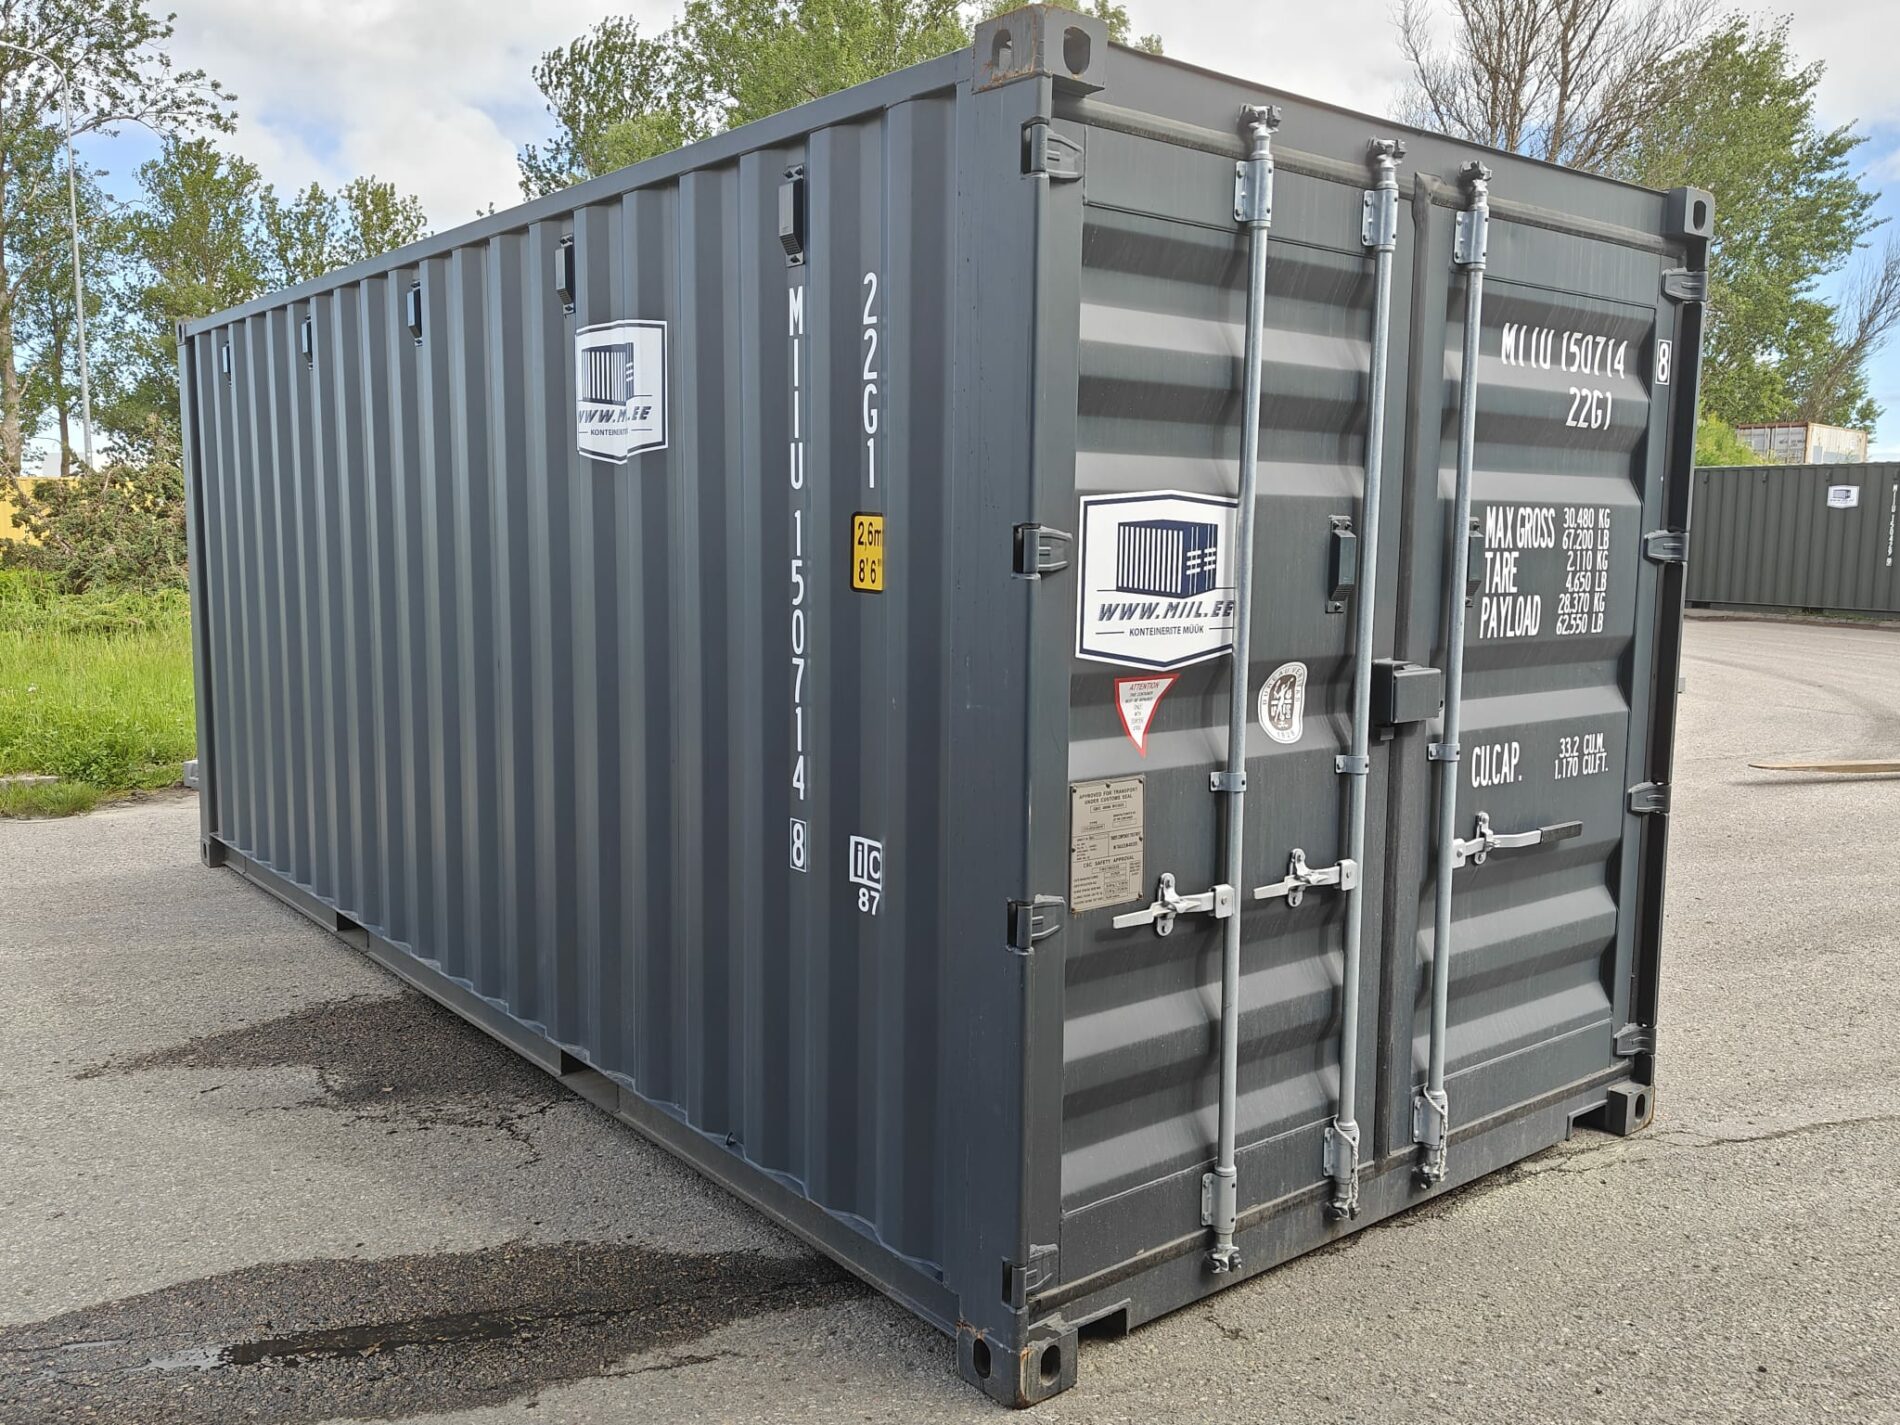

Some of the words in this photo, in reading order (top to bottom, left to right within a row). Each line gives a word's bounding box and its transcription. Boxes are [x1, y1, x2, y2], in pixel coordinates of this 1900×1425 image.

[1501, 322, 1555, 370] MIIU
[1561, 330, 1628, 379] 150714
[1657, 342, 1669, 382] 8
[789, 285, 804, 490] MIIU
[863, 272, 878, 488] 22G1
[1566, 386, 1612, 430] 22G1
[1485, 505, 1515, 549] MAX
[1516, 506, 1556, 549] GROSS
[1563, 507, 1594, 528] 30.480
[1598, 508, 1611, 528] KG
[1562, 529, 1593, 549] 67.200
[1597, 529, 1609, 549] LB
[1484, 551, 1519, 594] TARE
[1566, 551, 1592, 571] 2.110
[1596, 551, 1608, 571] KG
[1566, 571, 1591, 592] 4.650
[1595, 571, 1607, 592] LB
[1097, 600, 1235, 622] WWW.MIIL.EE
[1129, 625, 1182, 637] KONTEINERITE
[1182, 624, 1205, 635] MÜÜK
[1479, 595, 1541, 639] PAYLOAD
[1558, 593, 1589, 614] 28.370
[1593, 592, 1605, 612] KG
[1556, 613, 1588, 635] 62.550
[1591, 613, 1604, 633] LB
[790, 510, 805, 800] 150714
[1471, 741, 1523, 788] CU.CAP.
[1559, 736, 1579, 758] 33.2
[1554, 757, 1578, 779] 1.170
[792, 822, 805, 867] 8
[858, 887, 880, 916] 87
